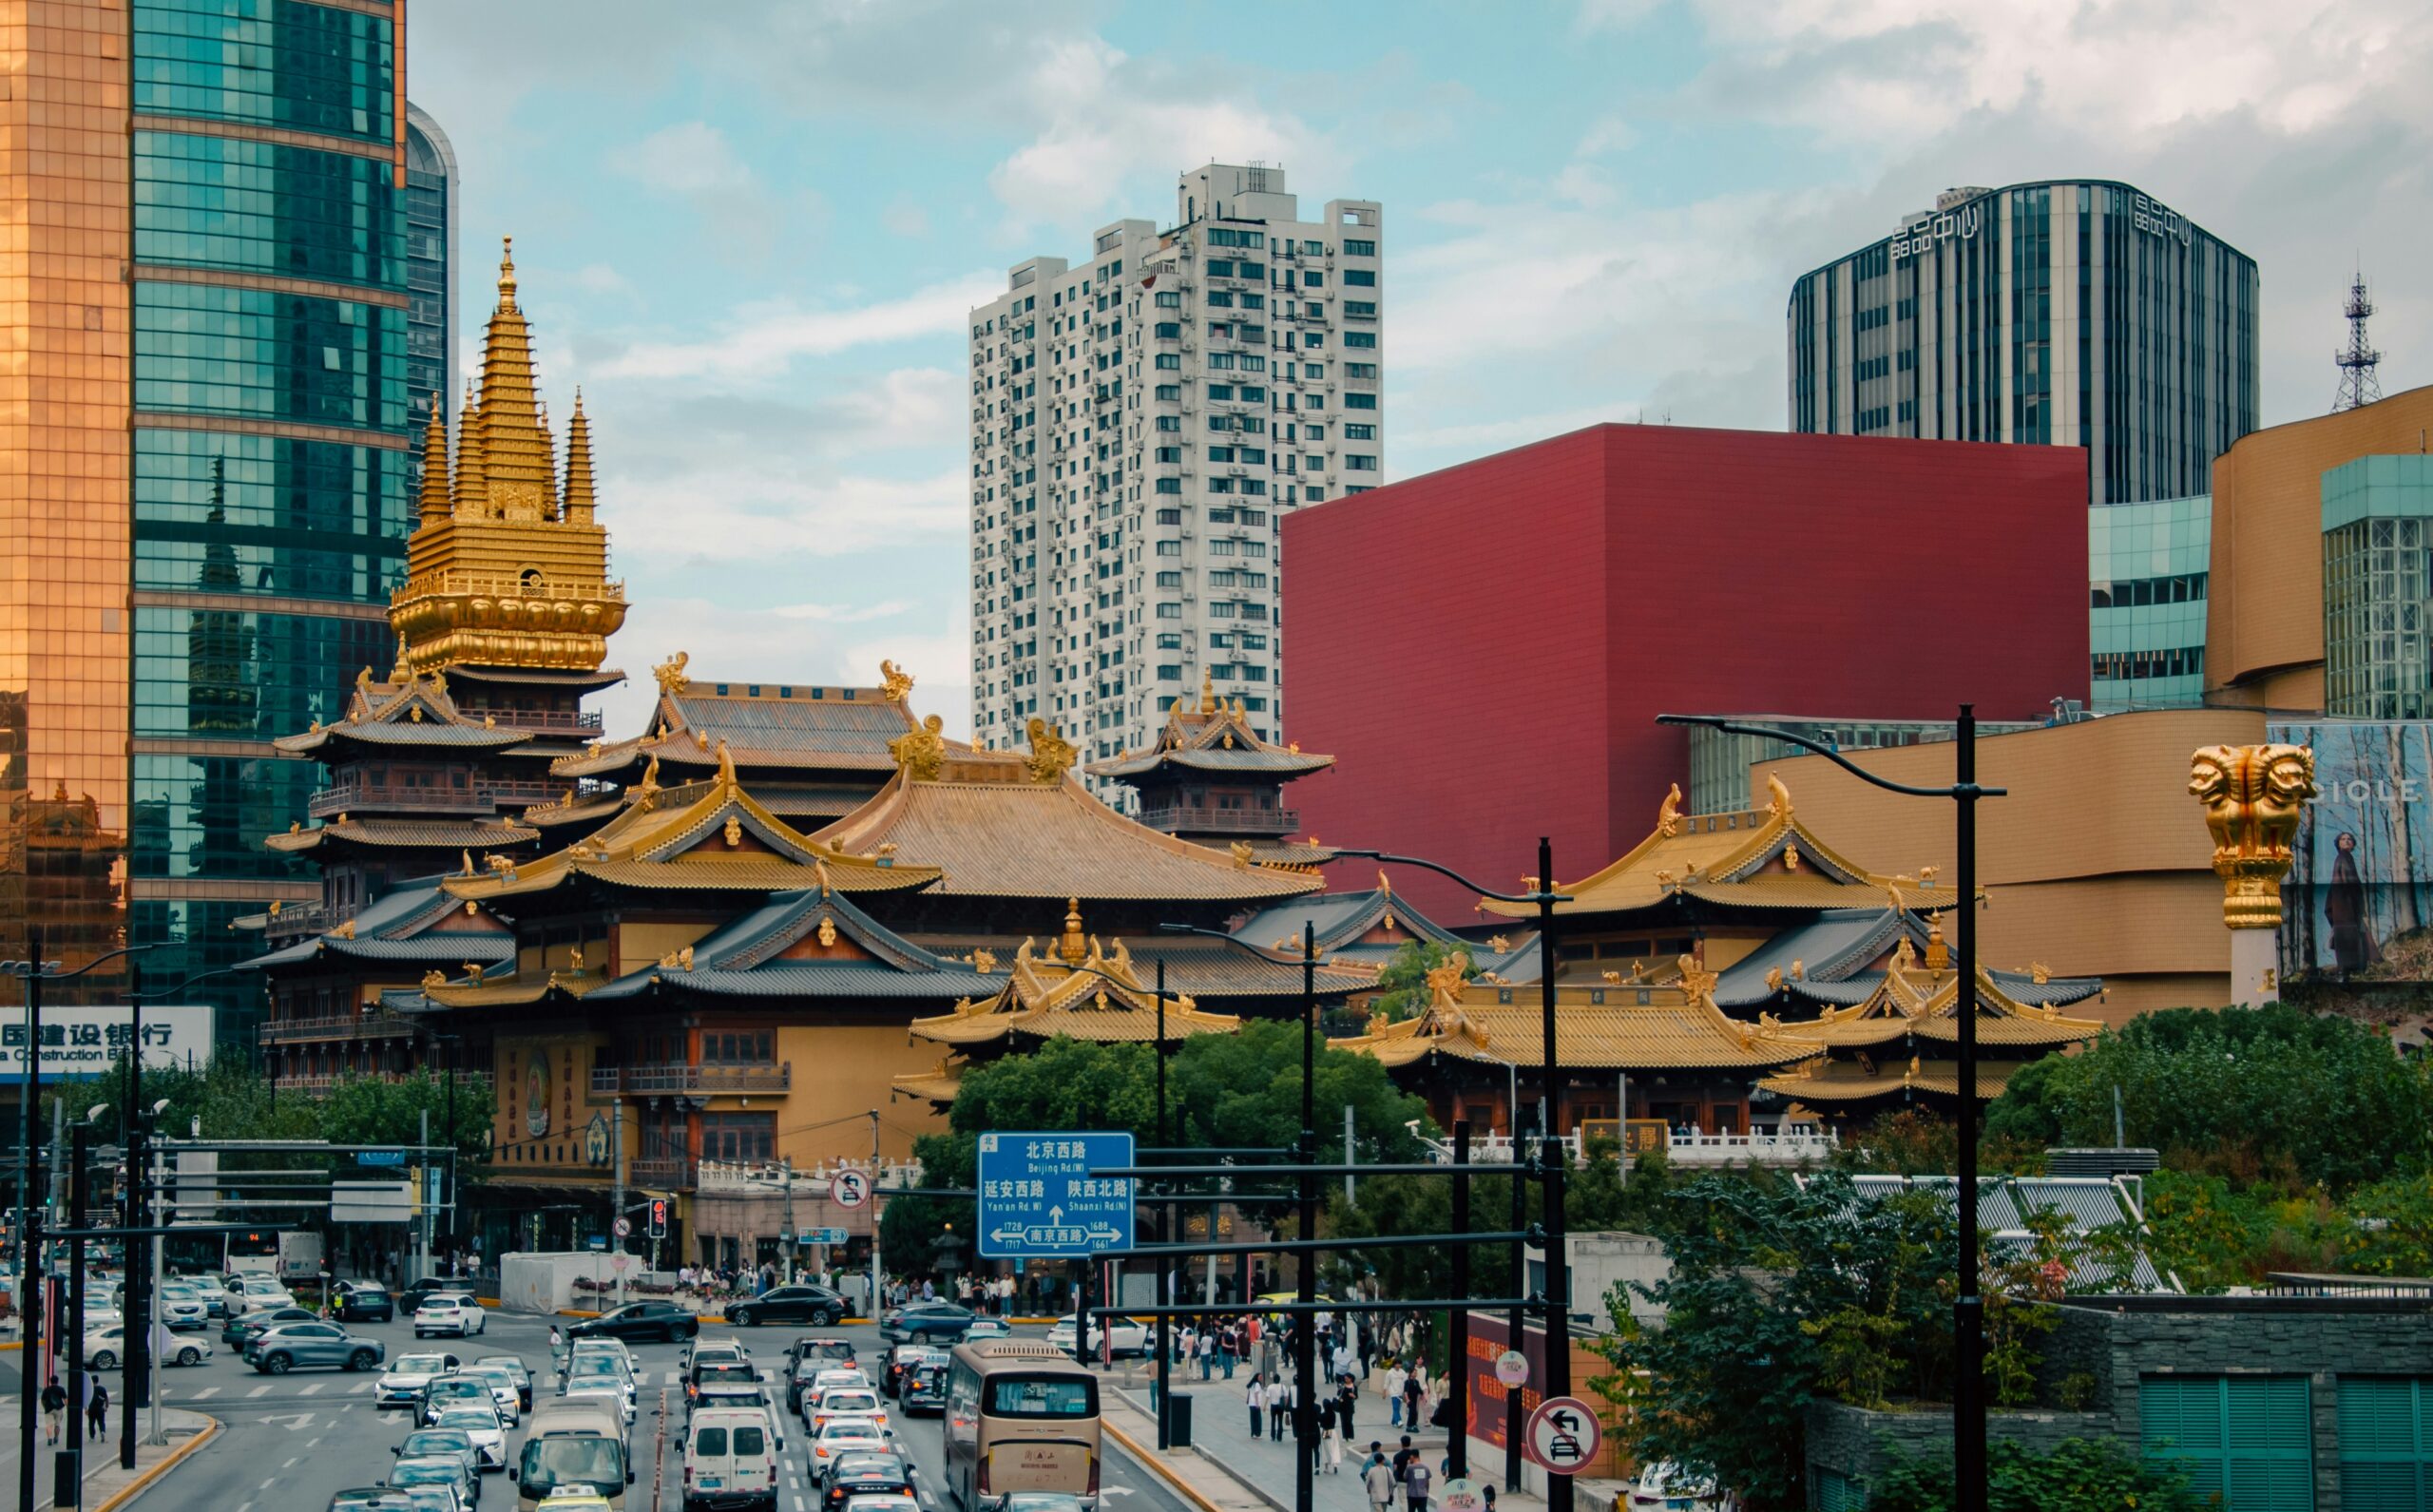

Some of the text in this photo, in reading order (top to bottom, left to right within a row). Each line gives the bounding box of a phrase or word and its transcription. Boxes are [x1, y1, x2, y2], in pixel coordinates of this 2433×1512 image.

[2, 1023, 172, 1046] 国建设银行
[1025, 1140, 1086, 1159] 北京西路
[1028, 1163, 1084, 1175] Beijing Rd.(W)
[985, 1179, 1044, 1198] 延安西路
[1067, 1179, 1127, 1198] 陕西北路
[987, 1201, 1016, 1212] Yan'an
[1068, 1201, 1102, 1212] Shaanxi
[1004, 1222, 1023, 1231] 1728
[1090, 1221, 1108, 1231] 1688
[1030, 1229, 1082, 1242] 南京西路
[1006, 1240, 1021, 1249] 1717
[1092, 1239, 1109, 1249] 1661
